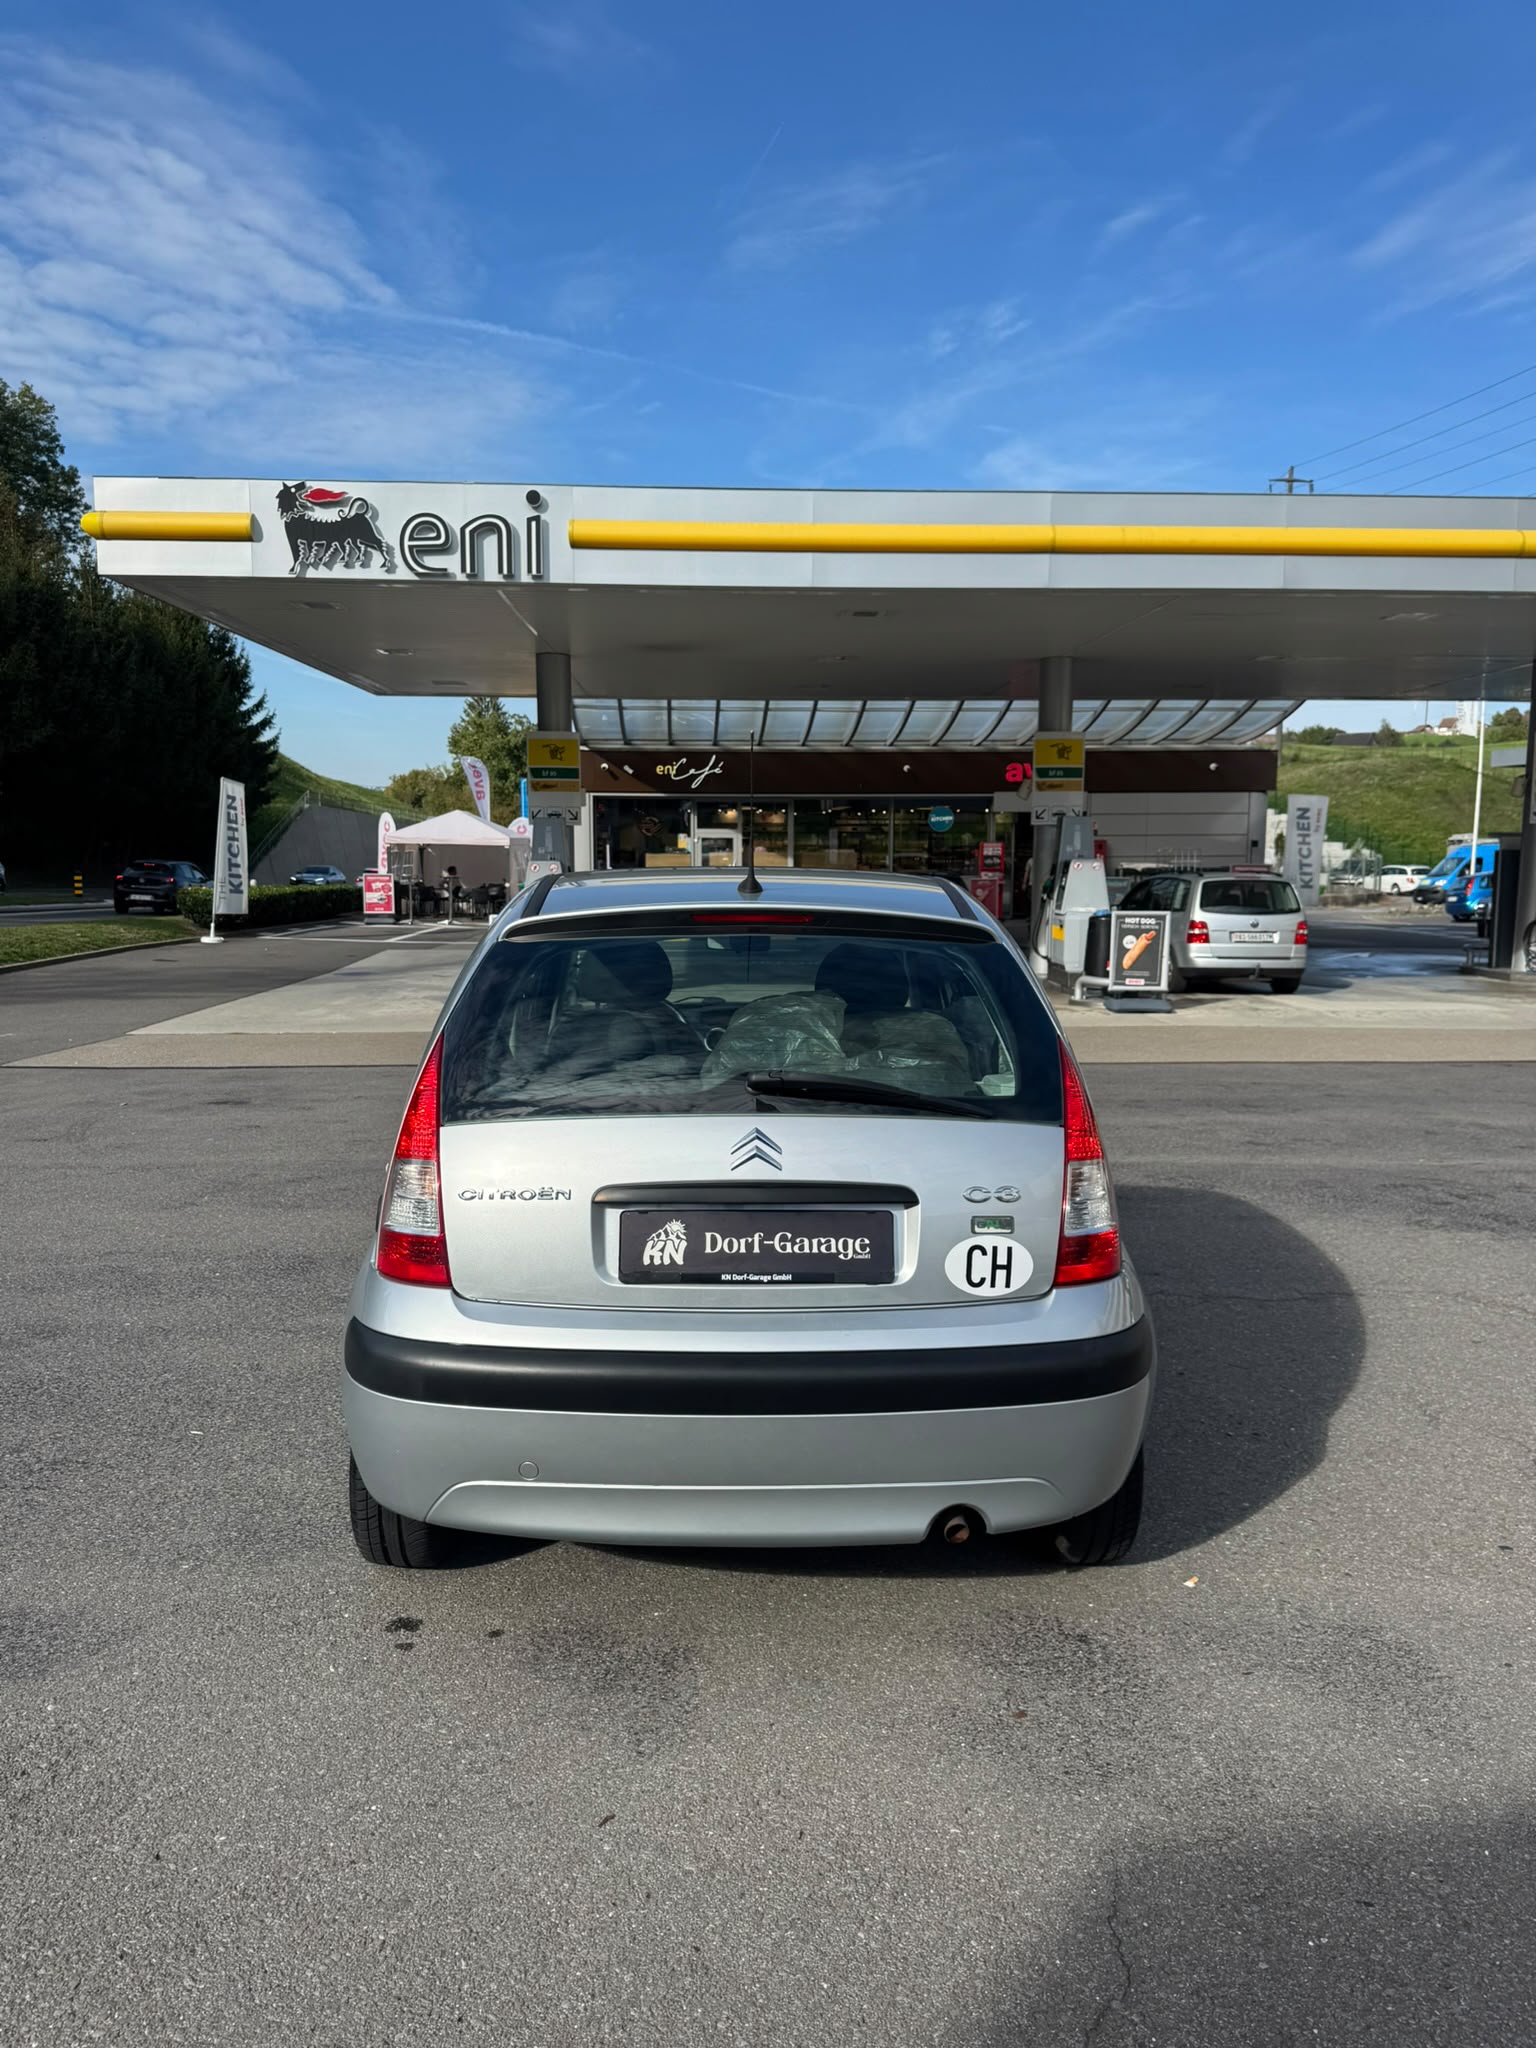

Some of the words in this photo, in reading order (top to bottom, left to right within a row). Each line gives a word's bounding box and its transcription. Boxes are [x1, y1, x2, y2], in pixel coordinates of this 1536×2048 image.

[400, 490, 543, 576] eni
[226, 794, 244, 895] KITCHEN
[1296, 806, 1314, 889] KITCHEN
[458, 1187, 571, 1201] CITROËN
[963, 1186, 1021, 1203] C3
[643, 1240, 687, 1266] KN
[705, 1232, 870, 1260] Dorf-Garage
[721, 1273, 732, 1281] KN
[732, 1273, 772, 1282] Dorf-Garage
[772, 1273, 792, 1281] GmbH
[966, 1244, 1012, 1289] CH
